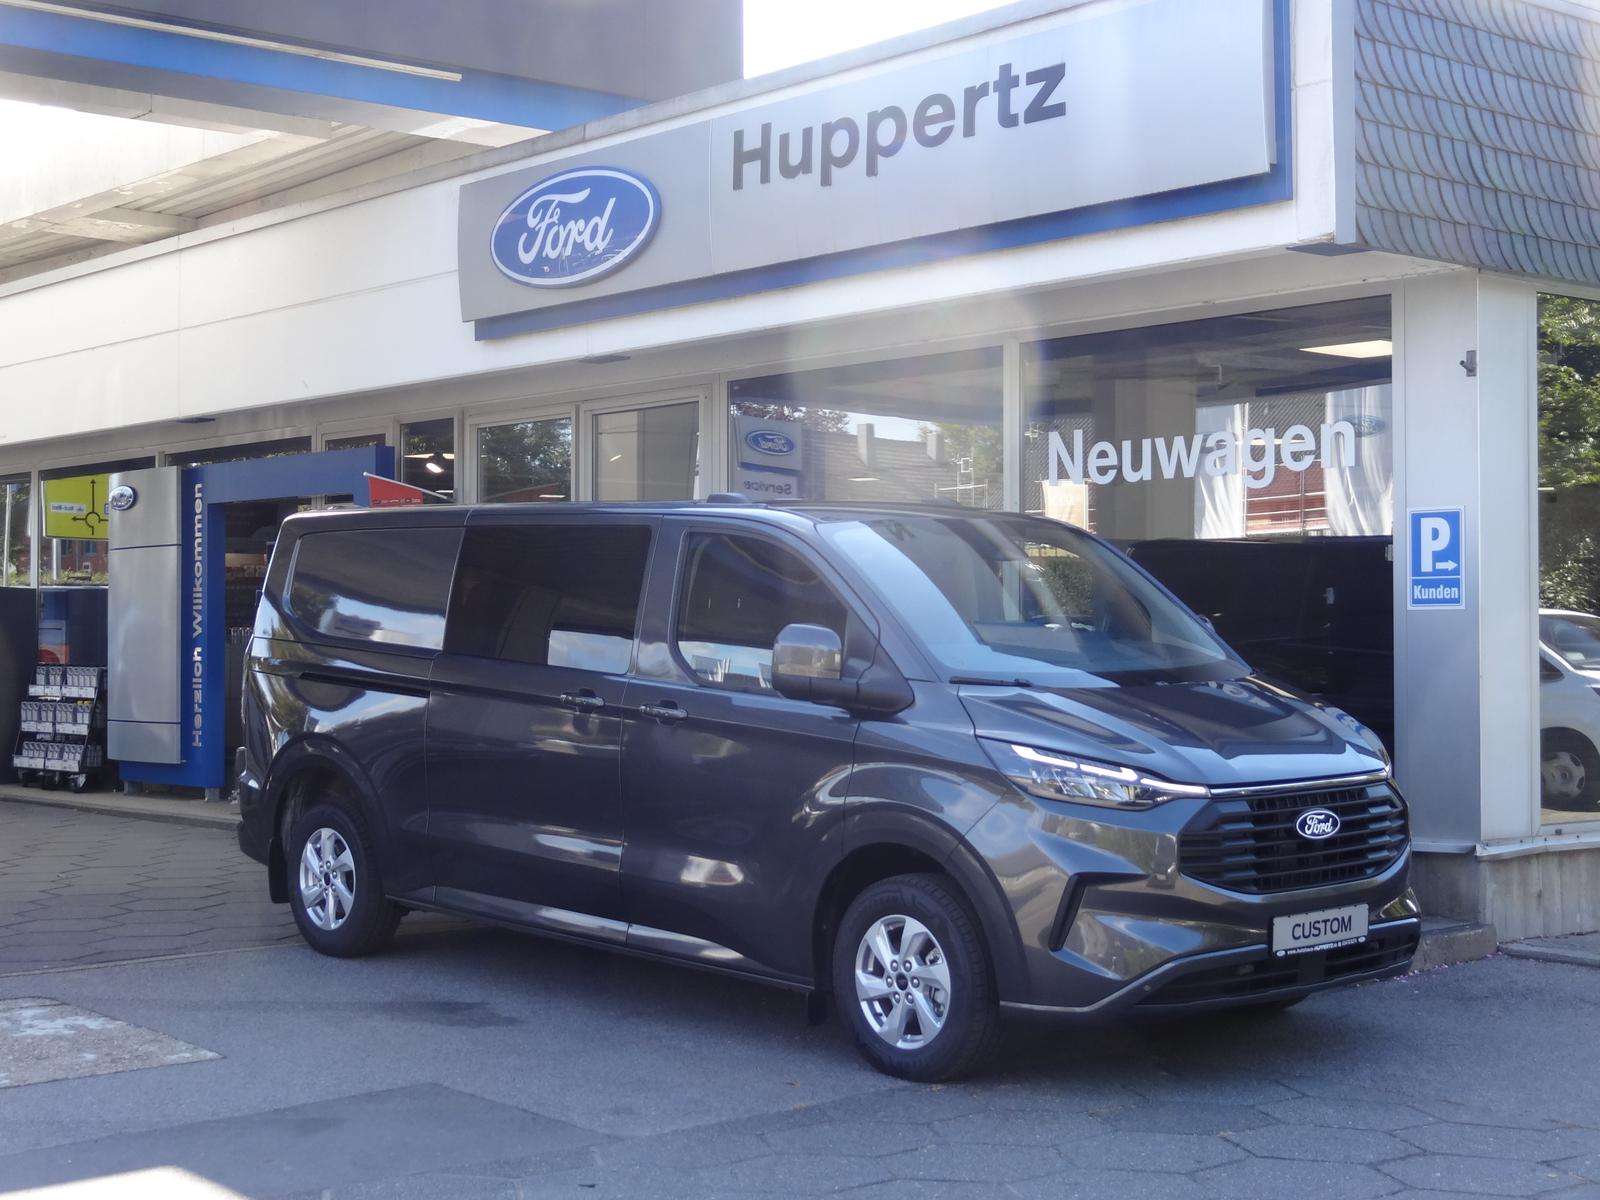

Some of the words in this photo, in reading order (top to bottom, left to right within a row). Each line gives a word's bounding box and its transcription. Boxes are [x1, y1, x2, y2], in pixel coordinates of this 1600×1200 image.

[732, 62, 1067, 190] Huppertz
[518, 187, 616, 264] Ford
[1048, 419, 1355, 489] Neuwagen
[192, 483, 203, 637] Willkommen
[1421, 517, 1450, 572] P
[1413, 585, 1458, 599] Kunden
[192, 646, 202, 747] Herzlich
[1305, 814, 1333, 834] Ford
[1292, 916, 1352, 940] CUSTOM
